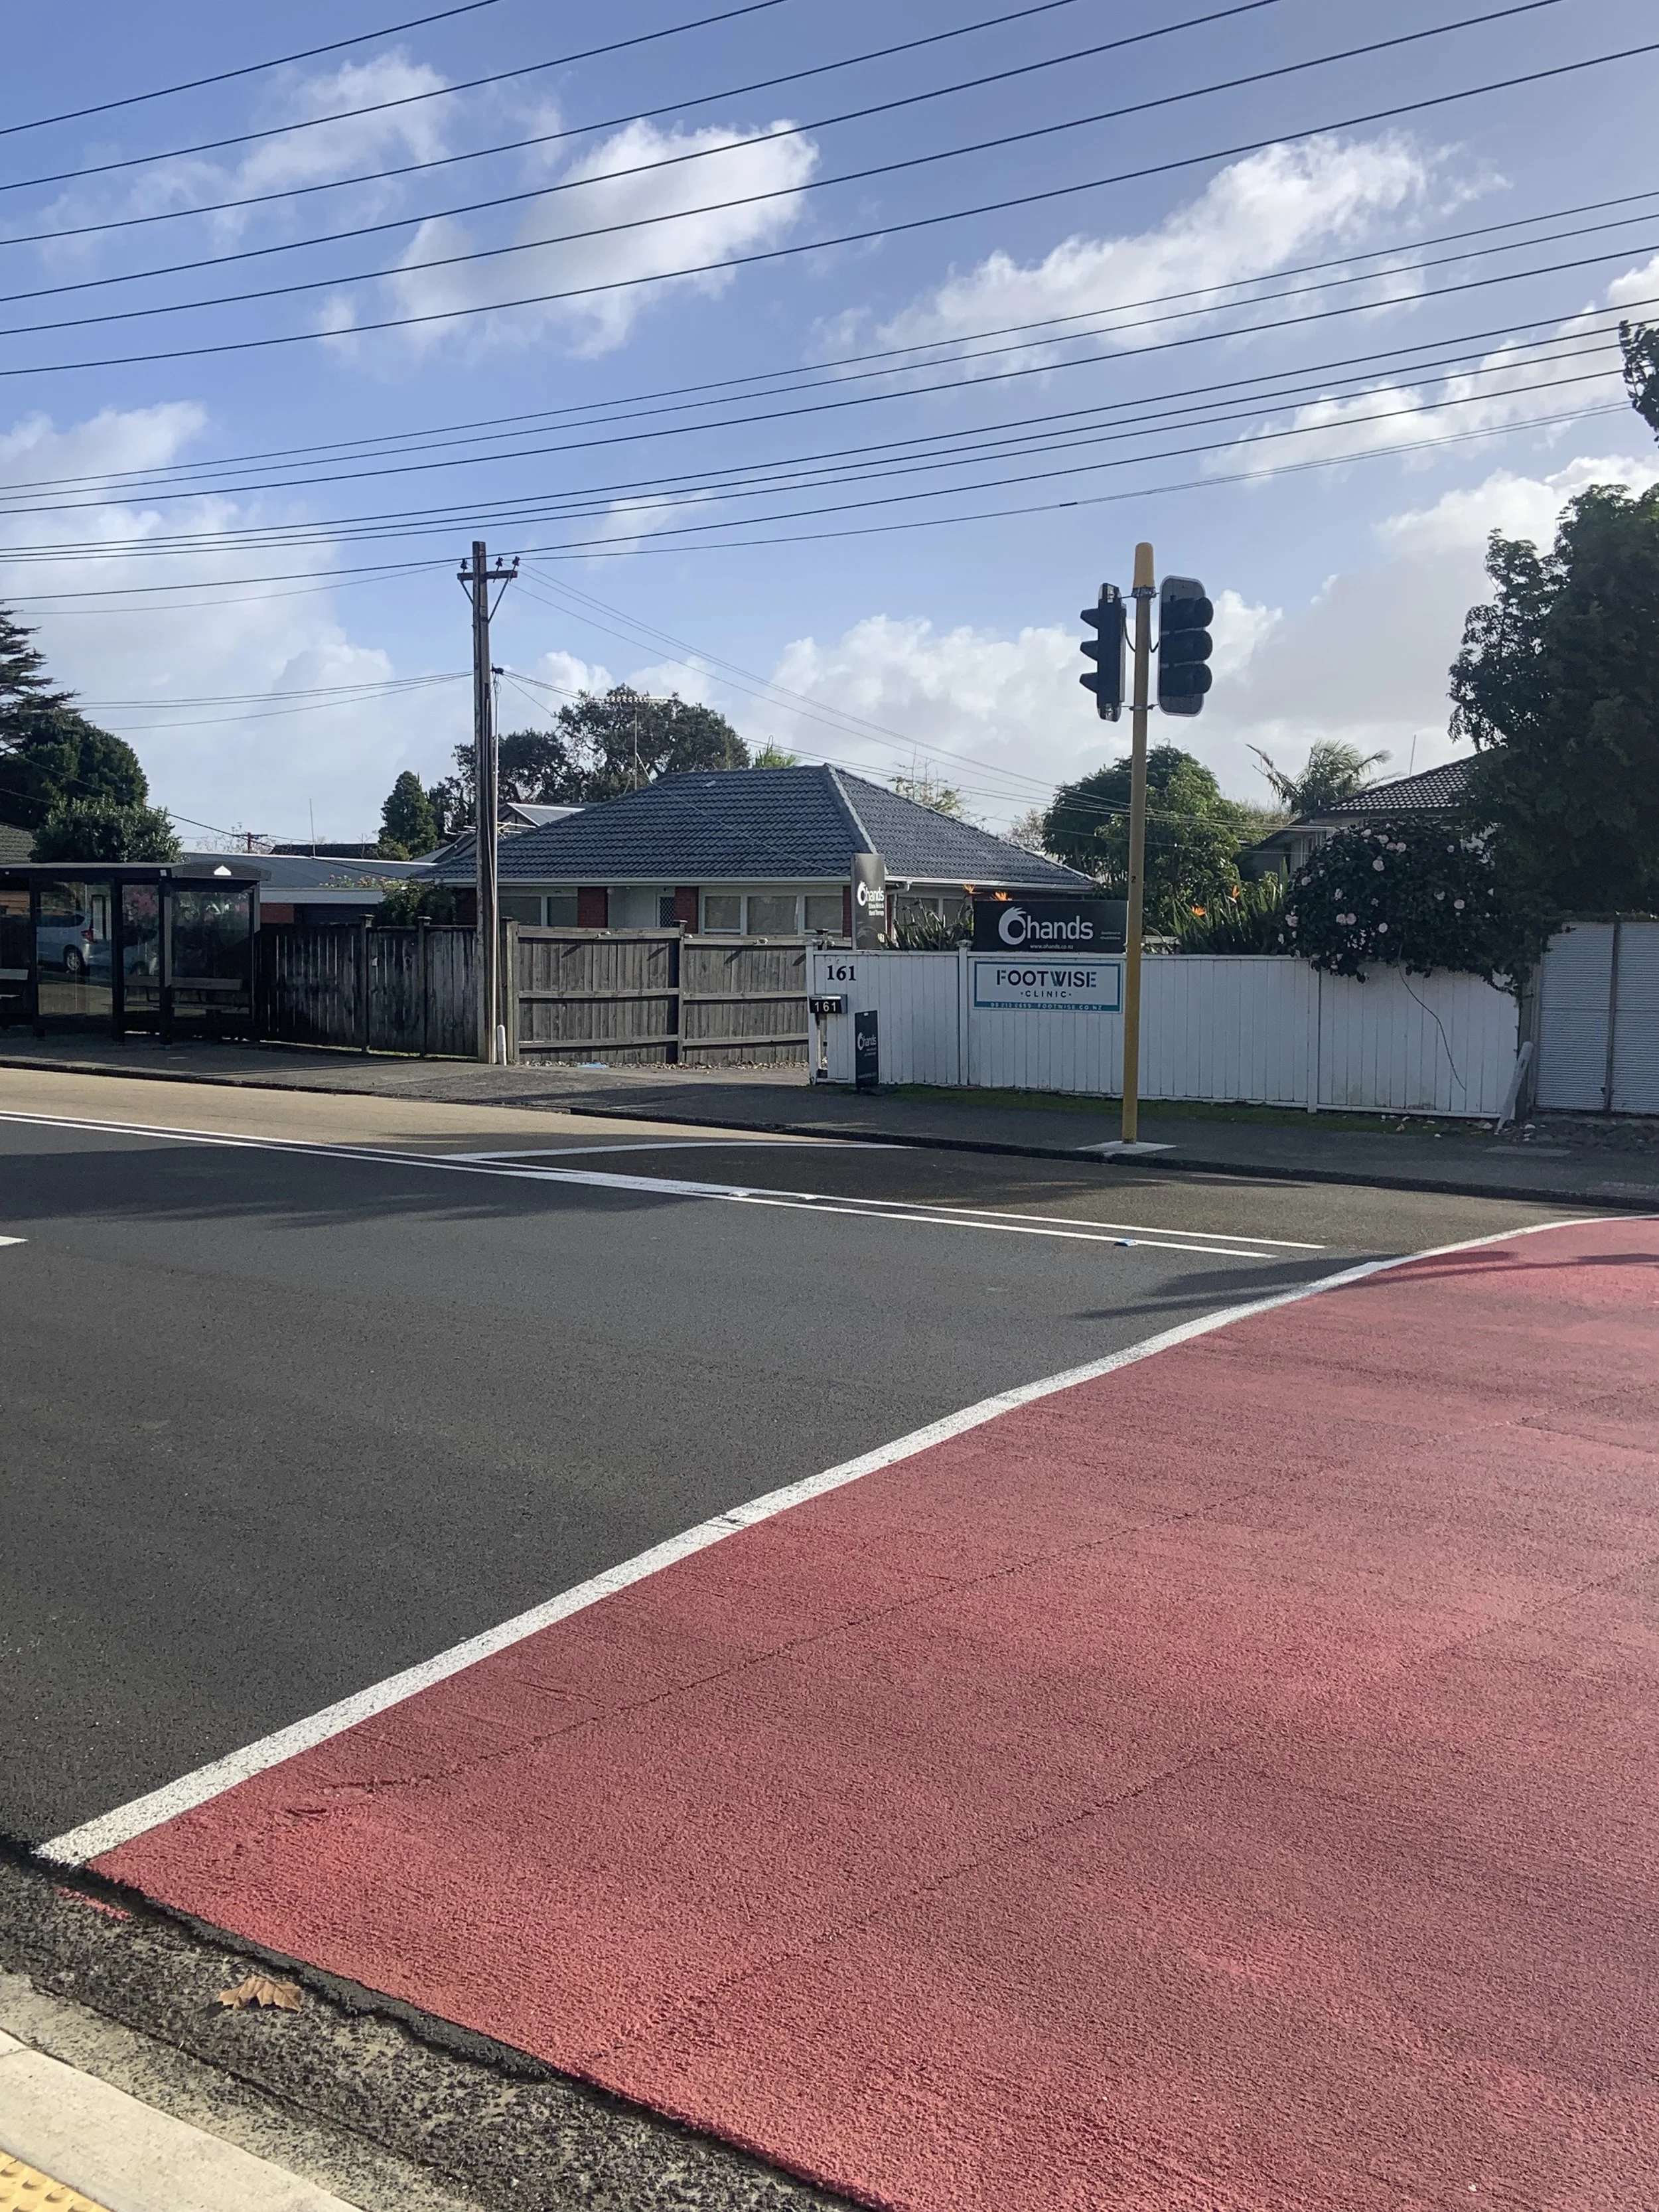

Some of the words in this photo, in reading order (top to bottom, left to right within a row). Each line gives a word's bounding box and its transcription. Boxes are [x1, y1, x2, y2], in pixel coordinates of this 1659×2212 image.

[828, 965, 856, 981] 161
[997, 970, 1097, 988] FOOTWISE
[814, 1001, 836, 1012] 161
